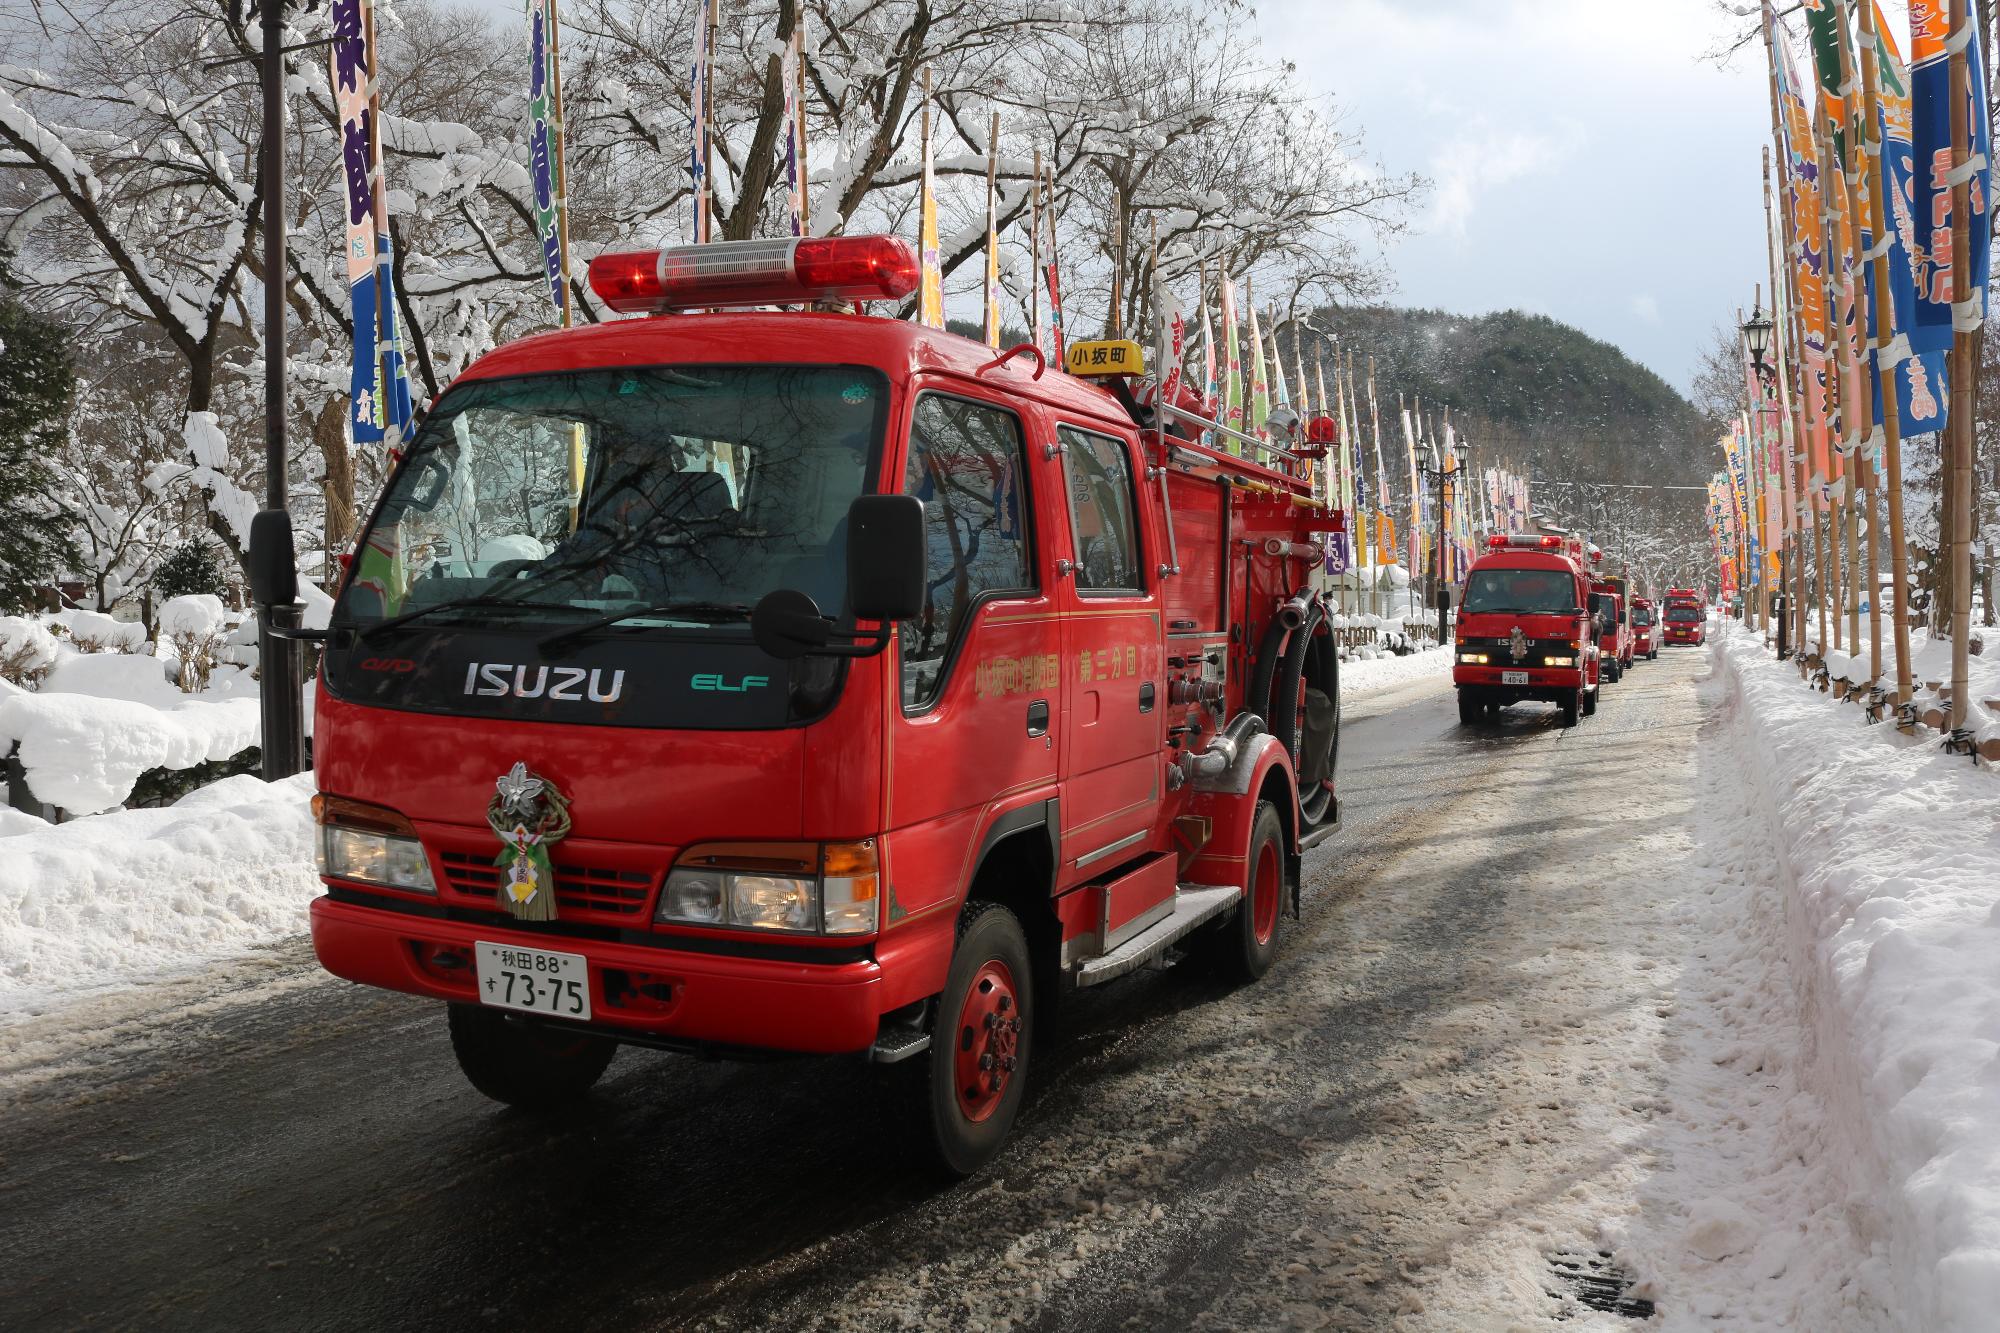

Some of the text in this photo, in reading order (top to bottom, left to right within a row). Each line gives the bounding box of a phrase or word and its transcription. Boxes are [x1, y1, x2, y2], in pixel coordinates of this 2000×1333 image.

[1072, 347, 1127, 366] 小坂町
[1498, 638, 1535, 647] ISU
[975, 654, 1059, 699] 小坂町消防団
[1080, 645, 1136, 684] 第三分団
[463, 662, 626, 703] ISUZU
[690, 674, 770, 692] ELF
[501, 950, 560, 973] 秋田 88
[484, 971, 584, 1014] す 73-75
